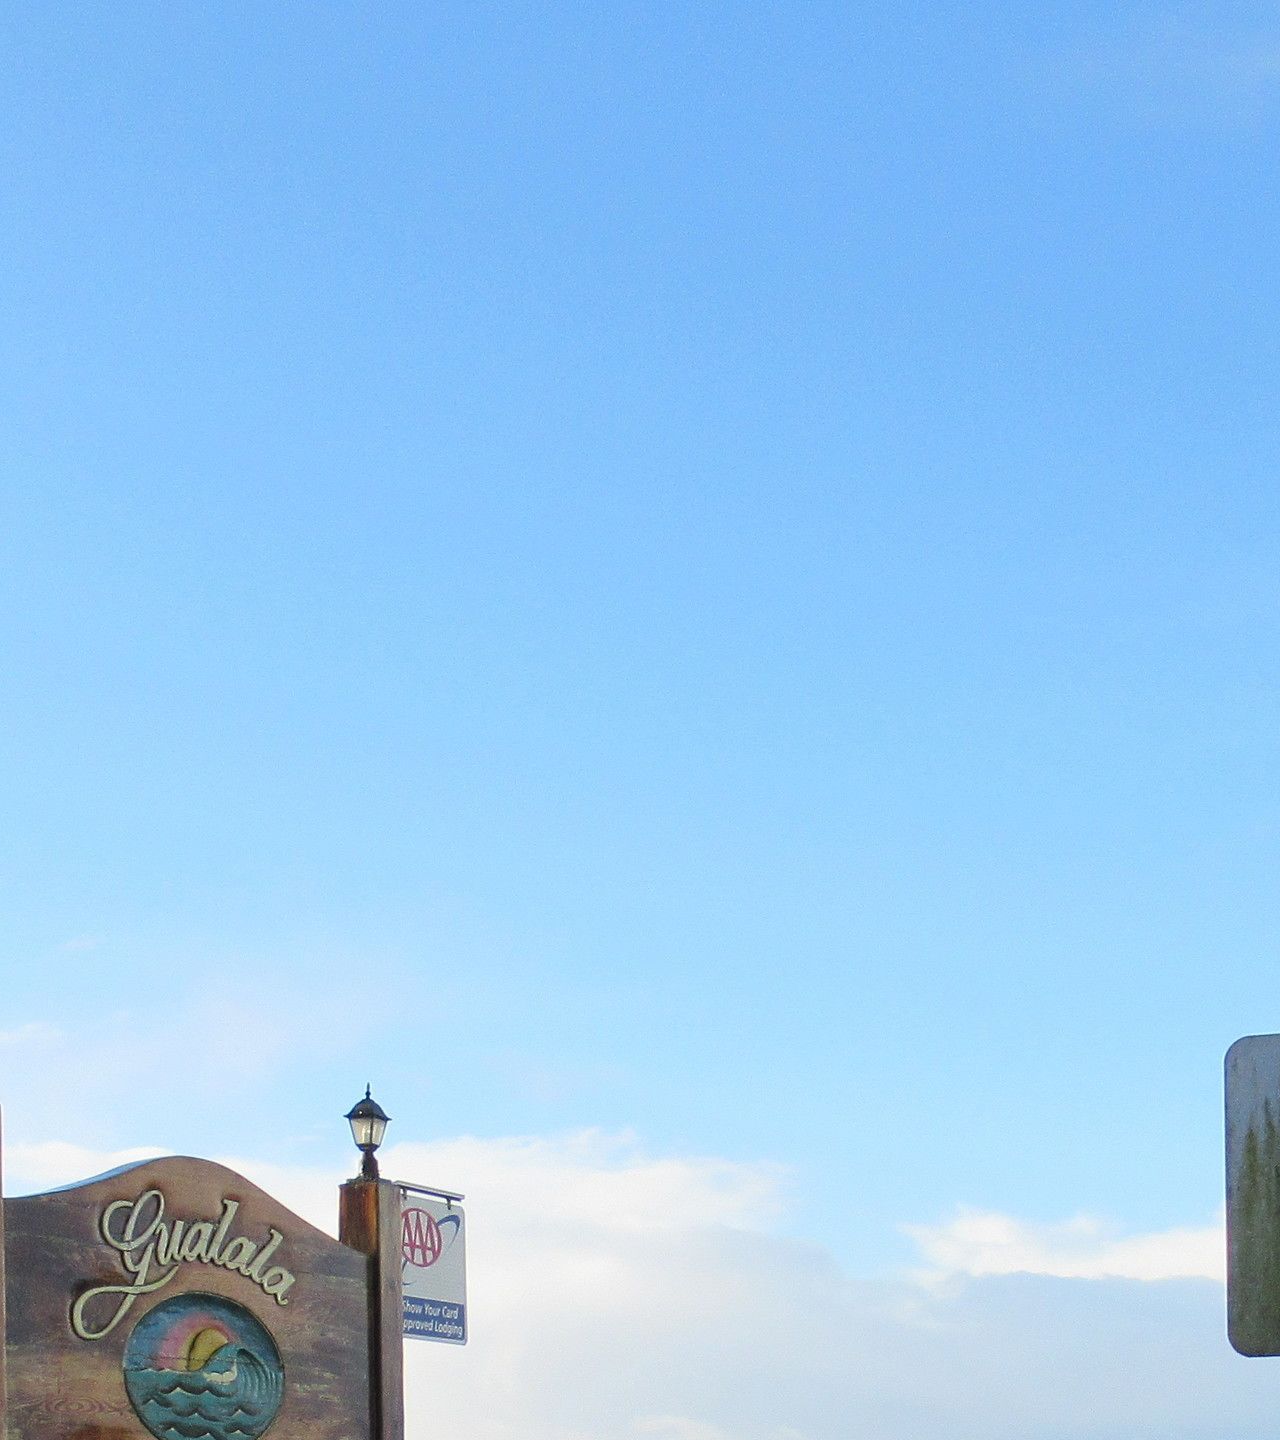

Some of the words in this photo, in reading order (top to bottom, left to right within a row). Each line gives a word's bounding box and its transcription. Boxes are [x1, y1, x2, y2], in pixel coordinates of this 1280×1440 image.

[402, 1209, 438, 1267] AAA
[71, 1189, 296, 1341] Gualala
[402, 1300, 423, 1314] Show
[424, 1303, 441, 1317] Your
[442, 1305, 459, 1320] Card
[402, 1318, 434, 1332] pproved
[434, 1320, 463, 1338] Lodging
